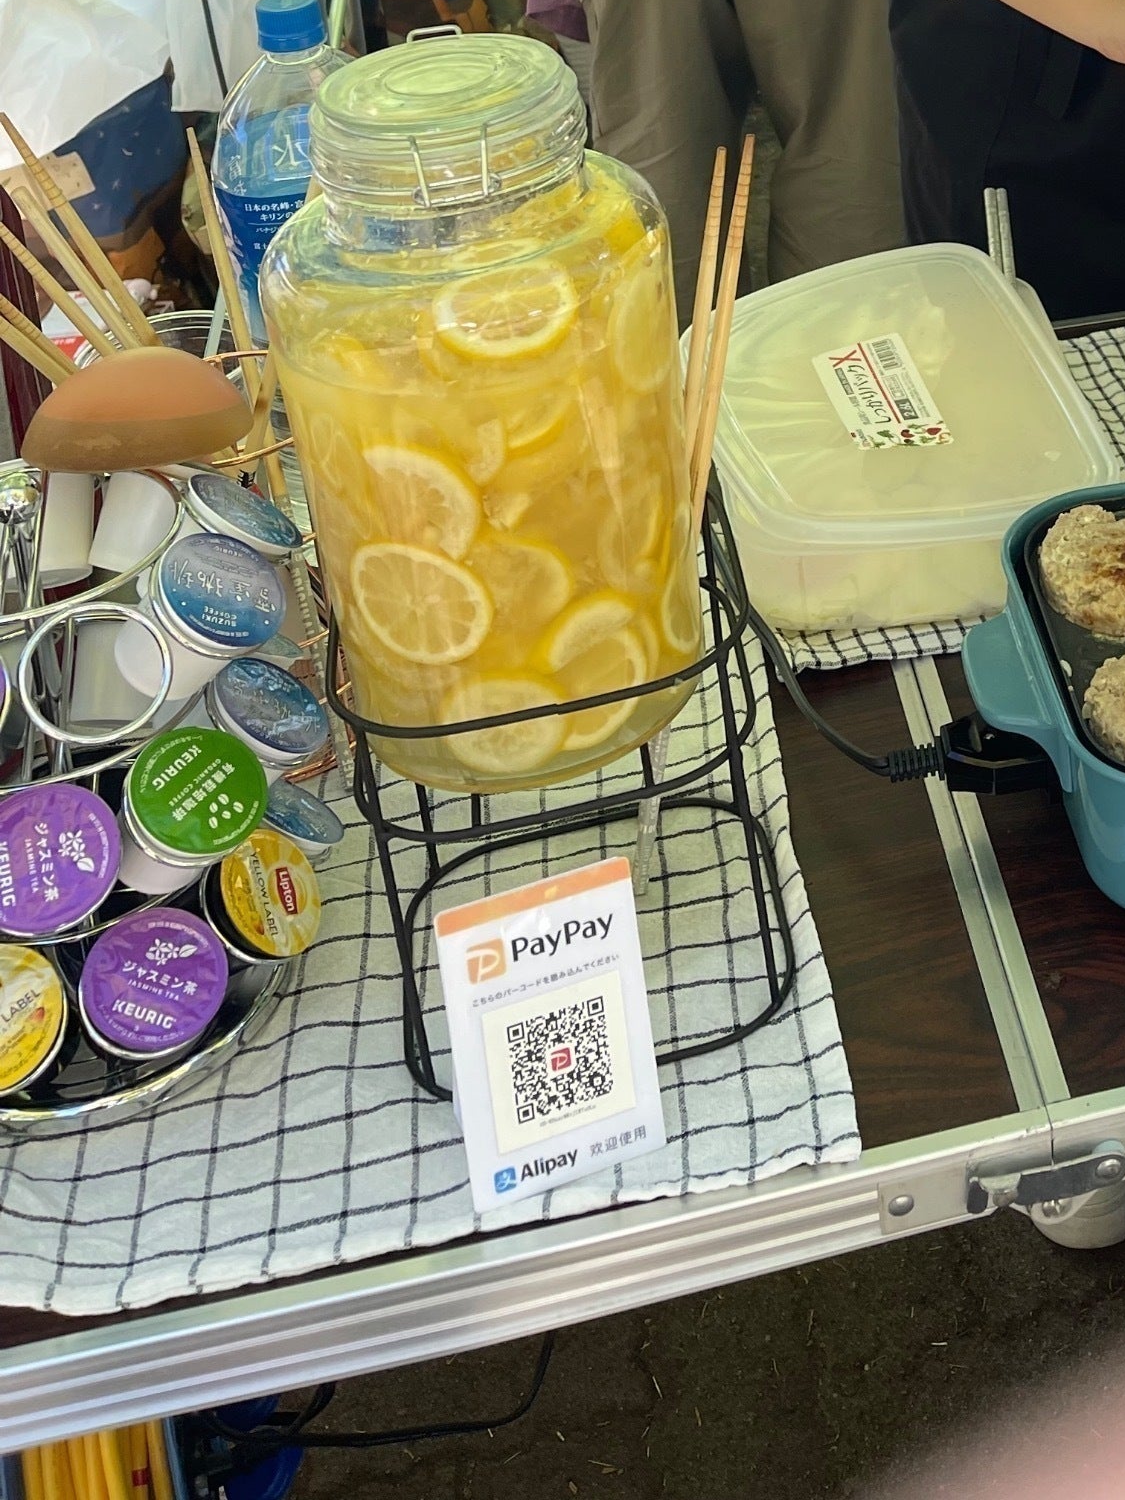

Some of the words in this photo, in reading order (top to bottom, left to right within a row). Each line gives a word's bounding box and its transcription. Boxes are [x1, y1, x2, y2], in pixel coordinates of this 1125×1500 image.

[152, 745, 202, 791] KEURIG
[194, 758, 221, 784] ORGANIC
[168, 783, 194, 806] COFFEE
[24, 838, 37, 875] JASMINE
[34, 822, 60, 902] ジャスミン茶
[30, 876, 40, 893] TEA
[249, 852, 269, 899] YELLOW
[263, 901, 279, 937] LABEL
[278, 870, 296, 912] Lipton
[511, 912, 614, 964] PayPay
[122, 960, 199, 996] ジャスミン茶
[128, 979, 165, 995] JASMINE
[164, 991, 180, 1002] TEA
[0, 988, 41, 1023] LABEL
[112, 999, 177, 1029] KEURIG
[588, 1125, 647, 1158] 欢迎使用
[520, 1147, 578, 1183] Alipay
